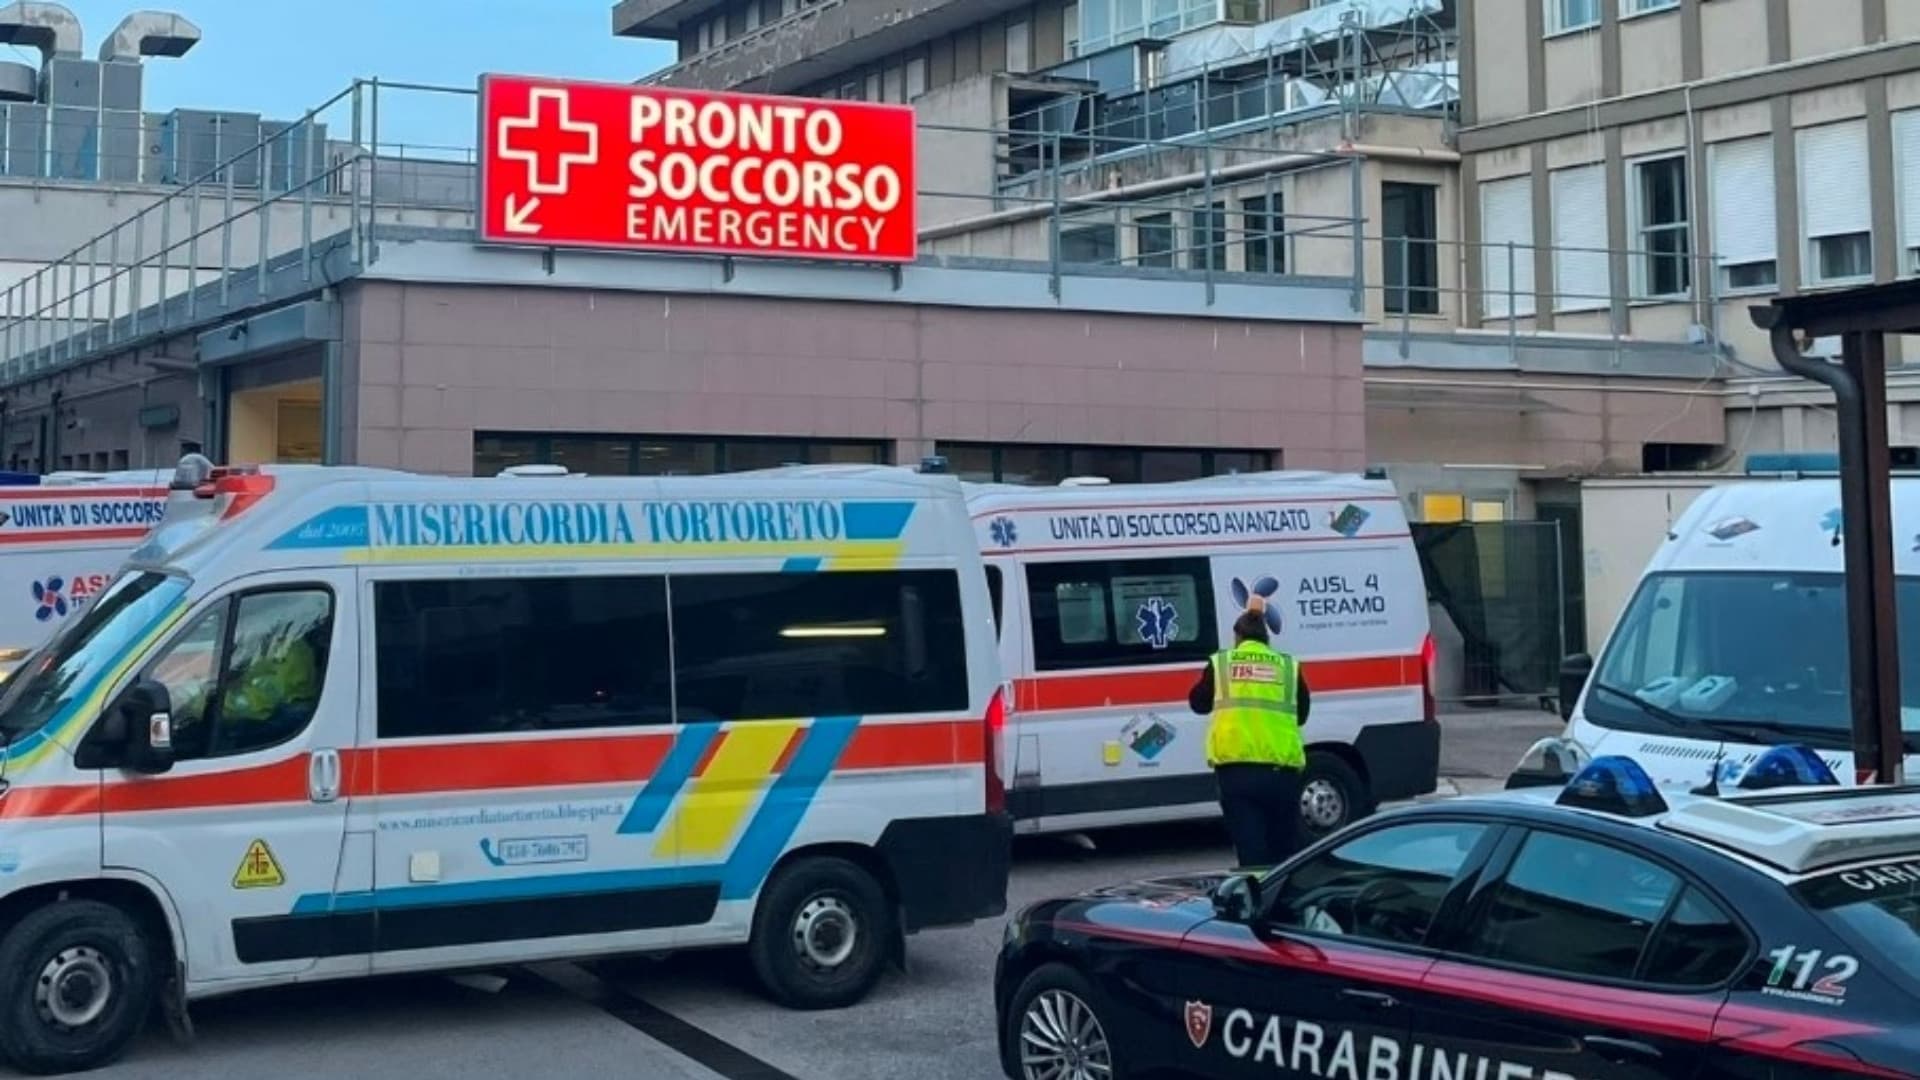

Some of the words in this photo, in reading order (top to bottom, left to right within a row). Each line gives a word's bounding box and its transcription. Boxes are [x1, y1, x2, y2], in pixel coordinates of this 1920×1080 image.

[629, 95, 843, 156] PRONTO
[628, 150, 900, 212] SOCCORSO
[626, 203, 886, 251] EMERGENCY
[70, 504, 88, 525] DI
[91, 501, 168, 523] SOCCORS
[374, 502, 633, 547] MISERICORDIA
[643, 501, 842, 544] TORTORETO
[1107, 515, 1126, 539] DI
[1128, 512, 1221, 537] SOCCORSO
[1224, 508, 1310, 533] AVANZATO
[1296, 595, 1385, 617] TERAMO
[1298, 576, 1355, 594] AUSL
[1364, 573, 1379, 592] 4
[1766, 944, 1860, 997] 112
[1222, 1008, 1577, 1080] CARABINI
